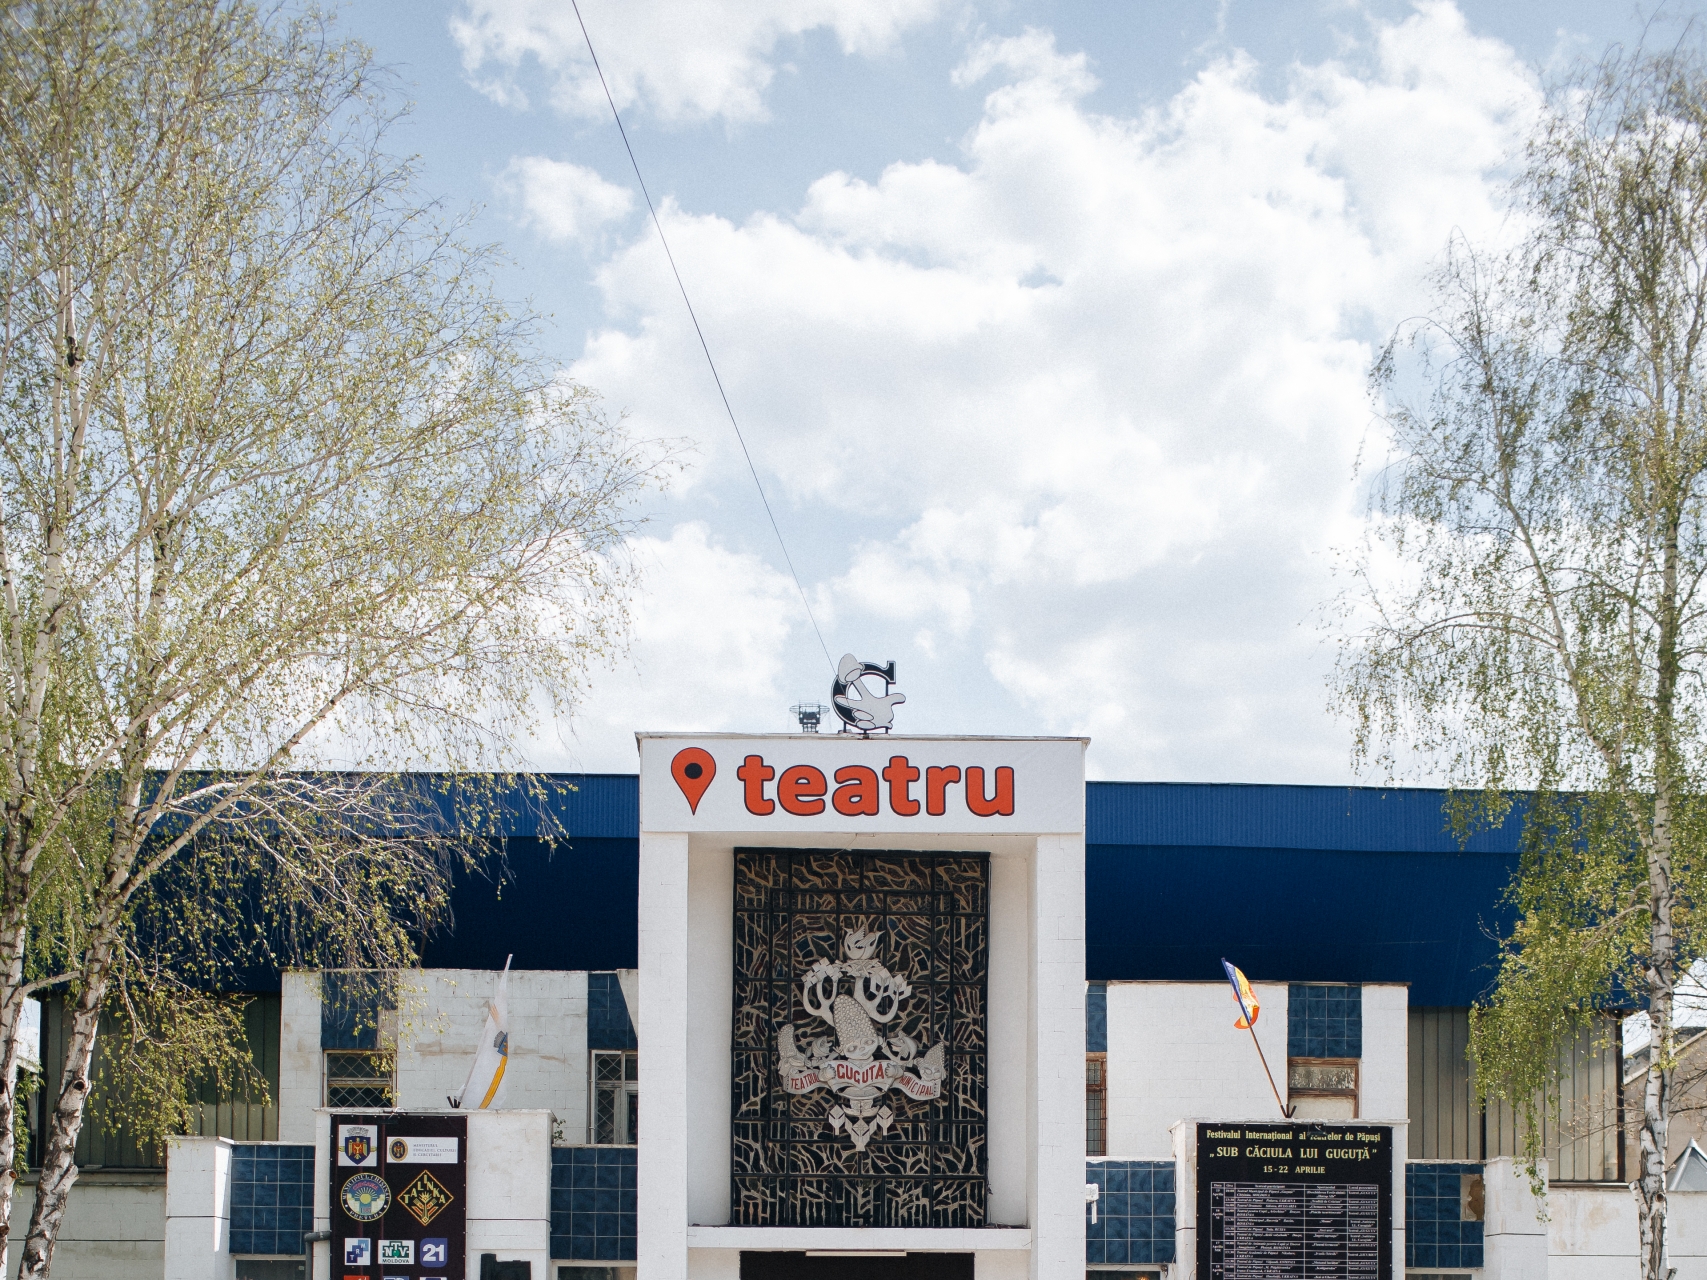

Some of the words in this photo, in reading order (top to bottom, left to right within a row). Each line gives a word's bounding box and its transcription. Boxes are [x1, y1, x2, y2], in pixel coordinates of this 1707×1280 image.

[736, 755, 1015, 817] teatru
[899, 1074, 934, 1096] MUNICIPAL
[1206, 1129, 1241, 1139] Festivalul
[1298, 1131, 1306, 1140] al
[1344, 1132, 1354, 1141] de
[1245, 1145, 1293, 1158] CĂCIULA
[1300, 1148, 1318, 1159] LUI
[1294, 1165, 1326, 1174] APRILIE
[422, 1243, 445, 1262] 21
